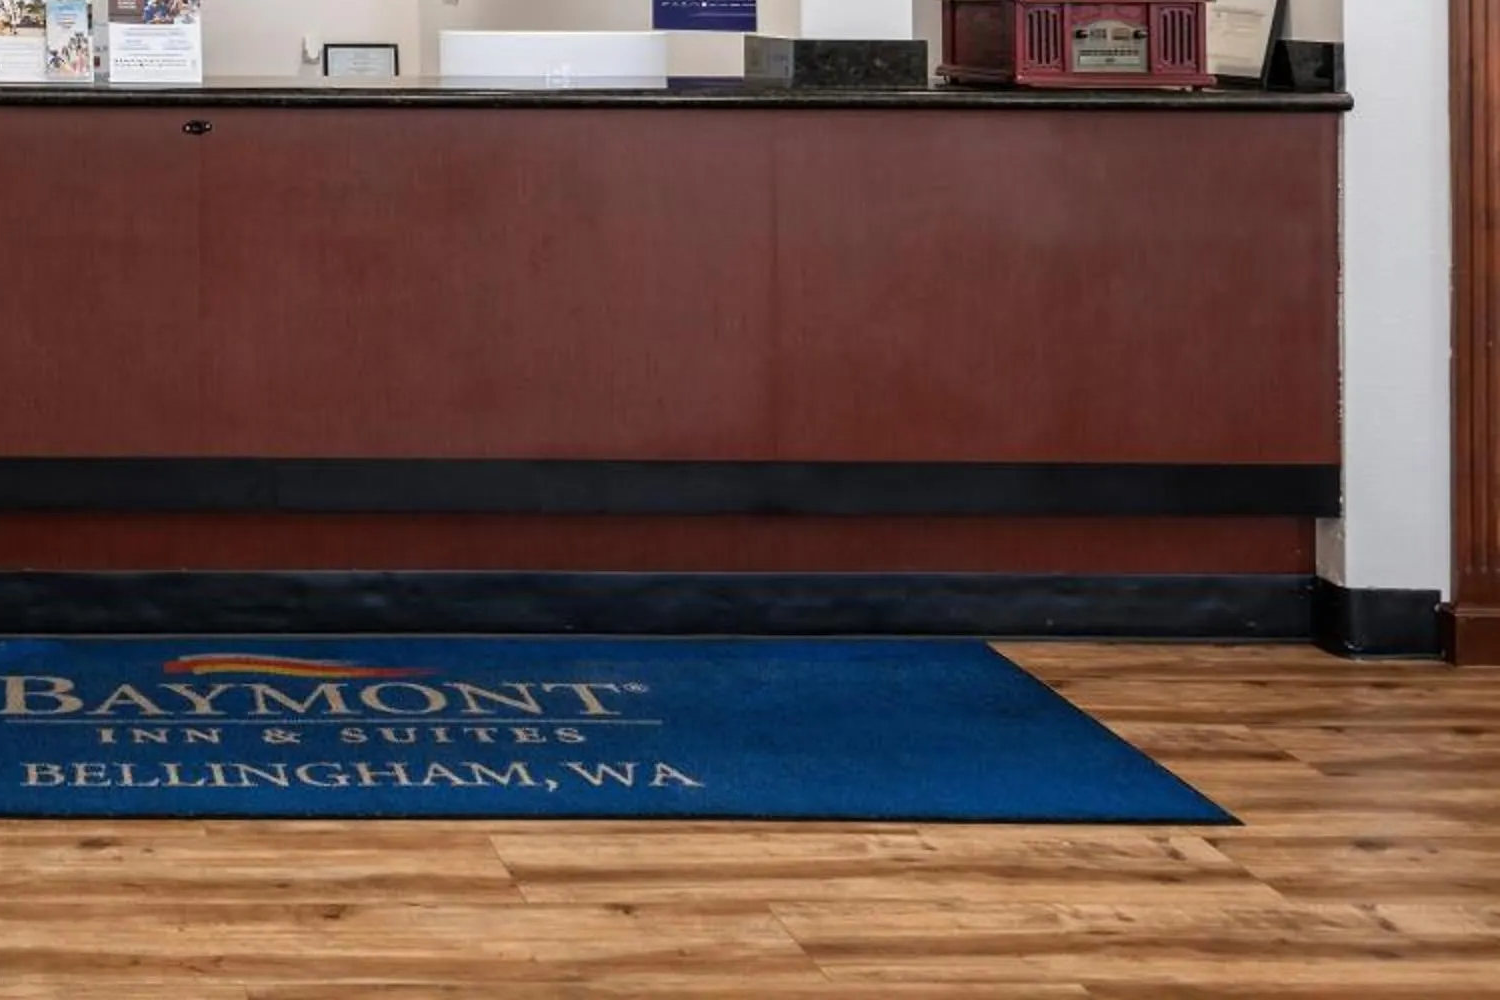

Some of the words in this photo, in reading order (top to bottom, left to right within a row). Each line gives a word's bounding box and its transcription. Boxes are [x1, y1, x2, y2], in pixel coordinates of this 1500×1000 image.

[96, 727, 224, 744] INN
[261, 727, 301, 744] &
[340, 727, 587, 744] SUITES
